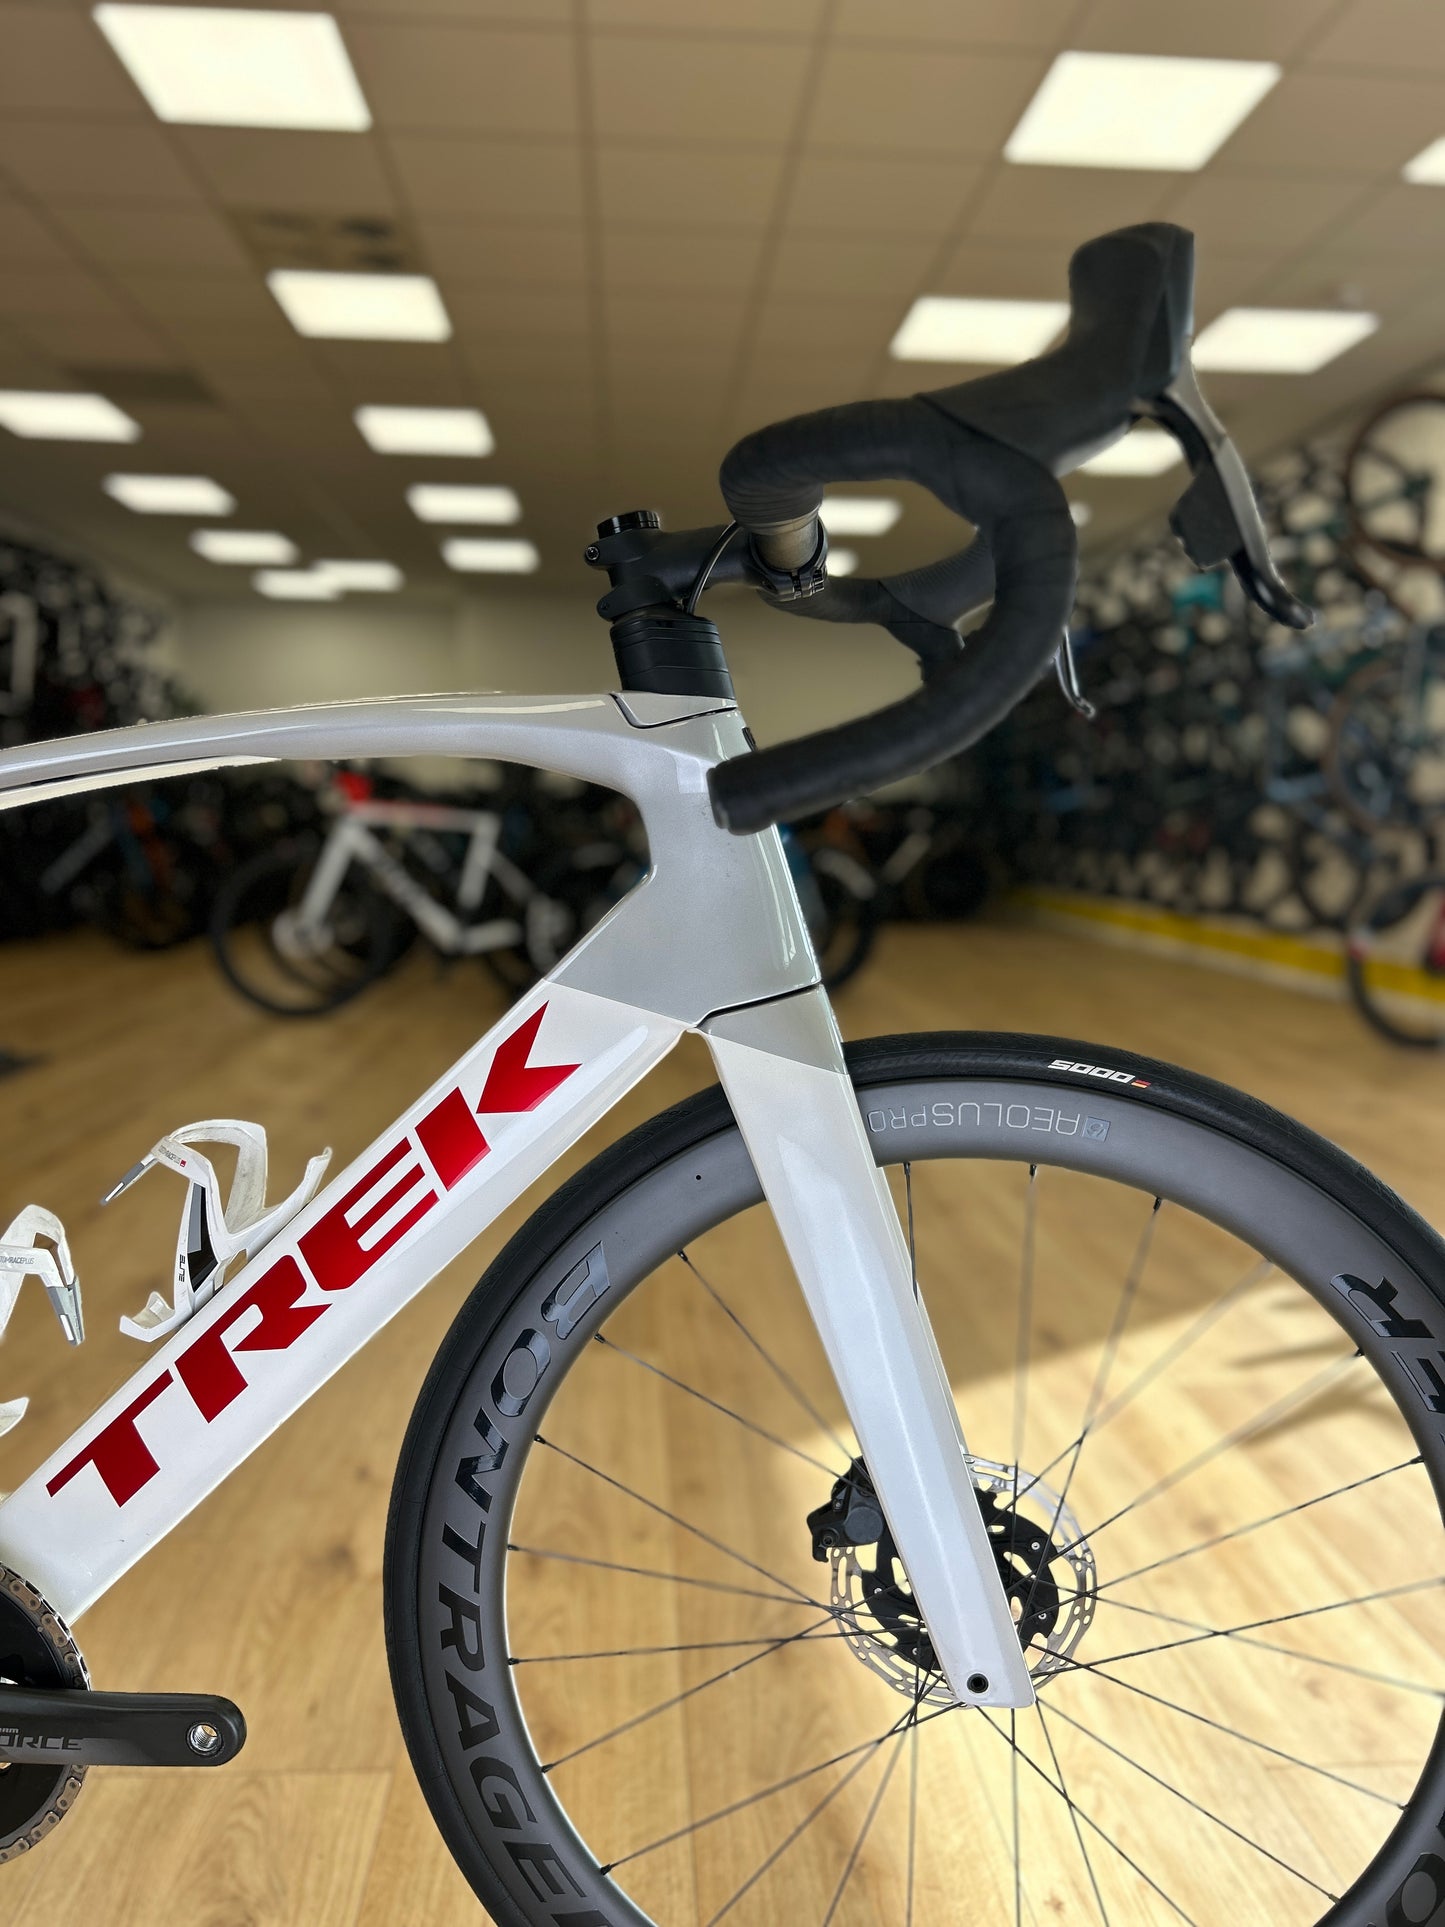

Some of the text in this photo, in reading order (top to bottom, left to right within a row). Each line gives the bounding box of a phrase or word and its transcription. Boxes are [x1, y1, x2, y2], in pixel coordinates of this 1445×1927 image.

[46, 1000, 582, 1507] TREK
[1047, 1059, 1136, 1084] 5000
[439, 1240, 614, 1927] BONTRAGE
